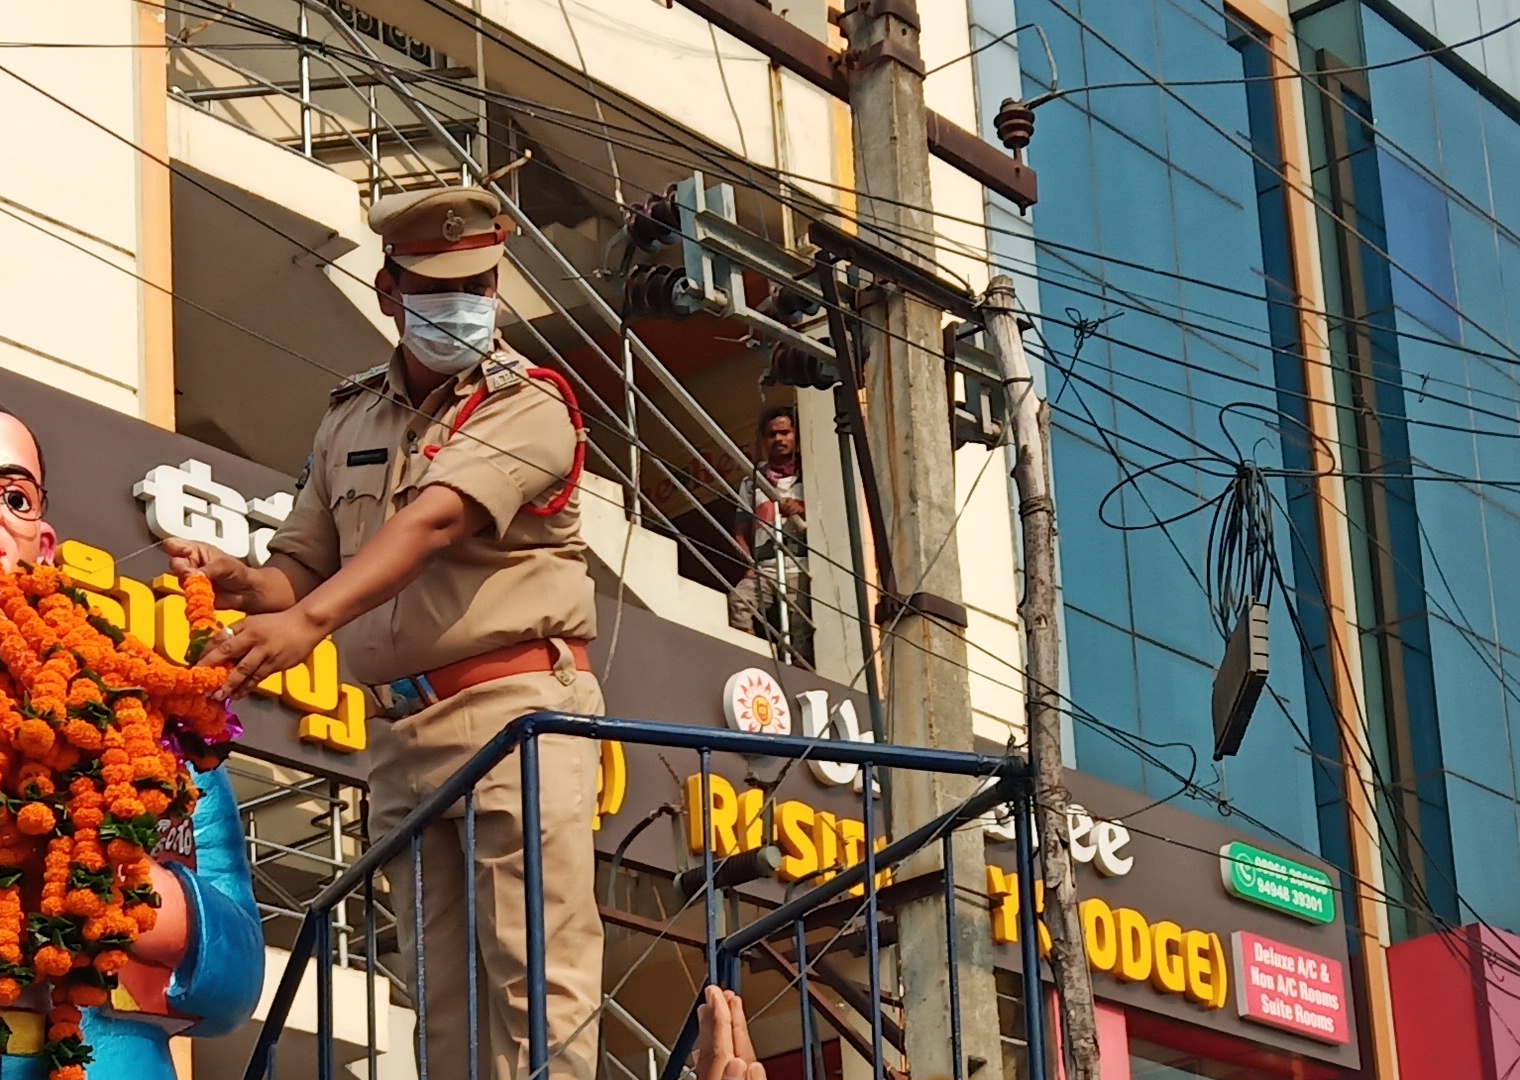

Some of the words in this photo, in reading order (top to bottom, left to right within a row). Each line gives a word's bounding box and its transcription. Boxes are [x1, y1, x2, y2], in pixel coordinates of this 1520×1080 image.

[1257, 878, 1291, 903] 94948
[1253, 941, 1295, 972] Deluxe
[1297, 956, 1318, 980] A/C
[1320, 963, 1330, 984] &
[1250, 965, 1275, 991] Non
[1277, 974, 1297, 998] A/C
[1299, 980, 1340, 1011] Rooms
[1260, 993, 1293, 1021] Suite
[1294, 1003, 1335, 1033] Rooms
